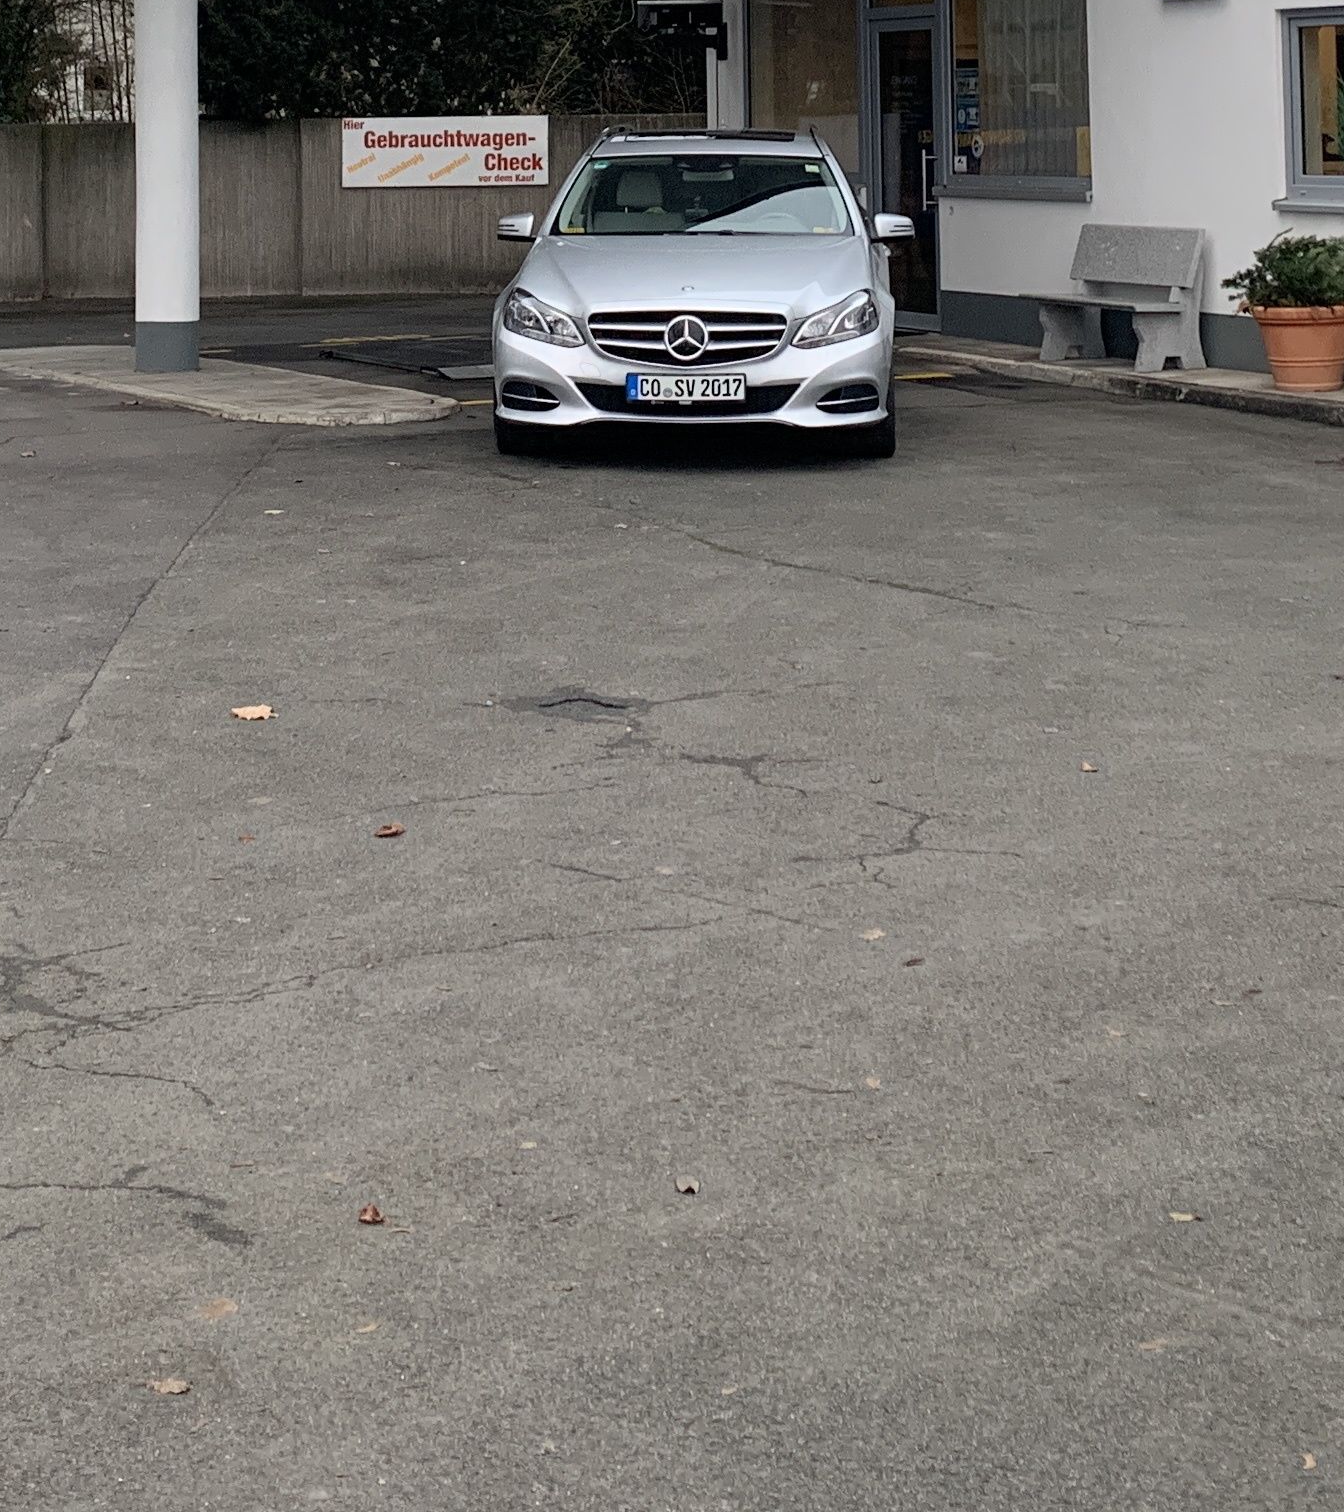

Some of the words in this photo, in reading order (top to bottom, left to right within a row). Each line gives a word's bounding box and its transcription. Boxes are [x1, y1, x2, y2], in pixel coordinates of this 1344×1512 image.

[343, 120, 365, 130] Hier
[363, 129, 536, 151] Gebrauchtwagen-
[484, 152, 544, 172] Check
[478, 175, 492, 183] vor
[494, 173, 513, 183] dem
[515, 173, 535, 183] Kauf
[640, 378, 661, 397] CO
[674, 378, 696, 397] SV
[700, 378, 742, 397] 2017
